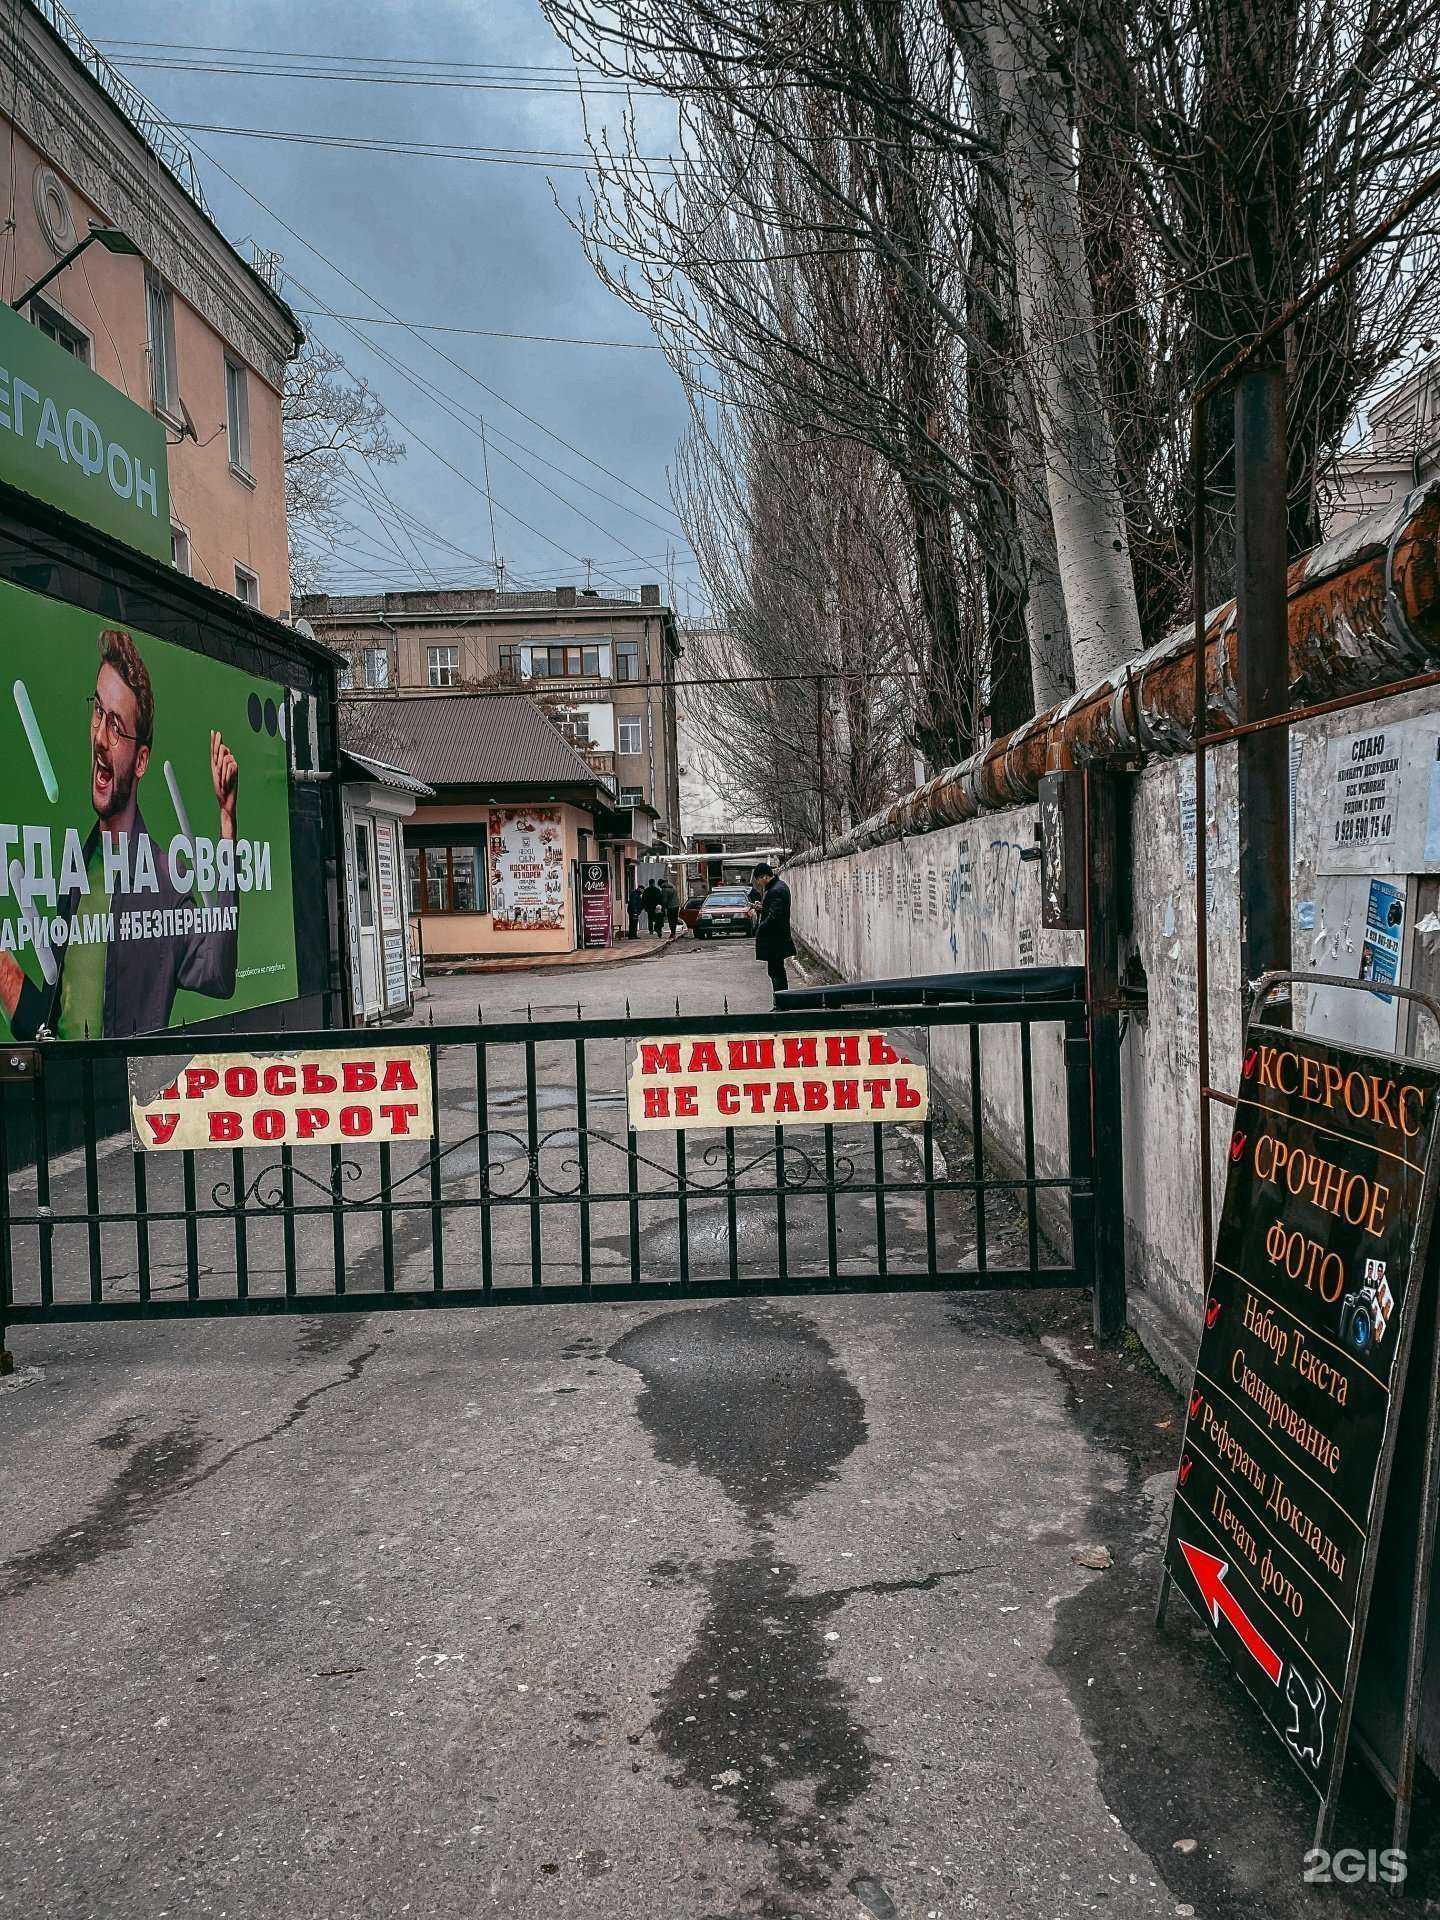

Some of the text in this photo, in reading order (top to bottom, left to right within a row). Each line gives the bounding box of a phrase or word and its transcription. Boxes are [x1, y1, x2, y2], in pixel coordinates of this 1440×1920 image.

[1352, 735, 1385, 762] СДАЮ
[1364, 758, 1399, 778] ДЕВУШКАМ
[1335, 821, 1341, 841] 8
[1370, 815, 1380, 838] 75
[1381, 814, 1392, 837] 40
[1363, 799, 1369, 812] С
[102, 831, 160, 894] НА
[168, 833, 272, 894] СВЯЗИ
[509, 863, 544, 872] КОСМЕТИКА
[119, 906, 238, 941] #БЕЗПЕРЕПЛАТ
[343, 801, 360, 1005] КСЕРОКС
[162, 1059, 419, 1100] РОСЬБА
[642, 1078, 922, 1119] НЕ СТАВИТЬ
[1257, 1045, 1425, 1137] КСЕРОКС
[145, 1104, 419, 1145] У ВОРОТ
[1255, 1134, 1391, 1239] СРОЧНОЕ
[1266, 1219, 1345, 1303] ФОТО
[1242, 1293, 1349, 1407] Набор Текста
[1231, 1349, 1341, 1474] Сканирование
[1200, 1402, 1347, 1583] Рефераты Доклады
[1210, 1484, 1305, 1619] Печать фото
